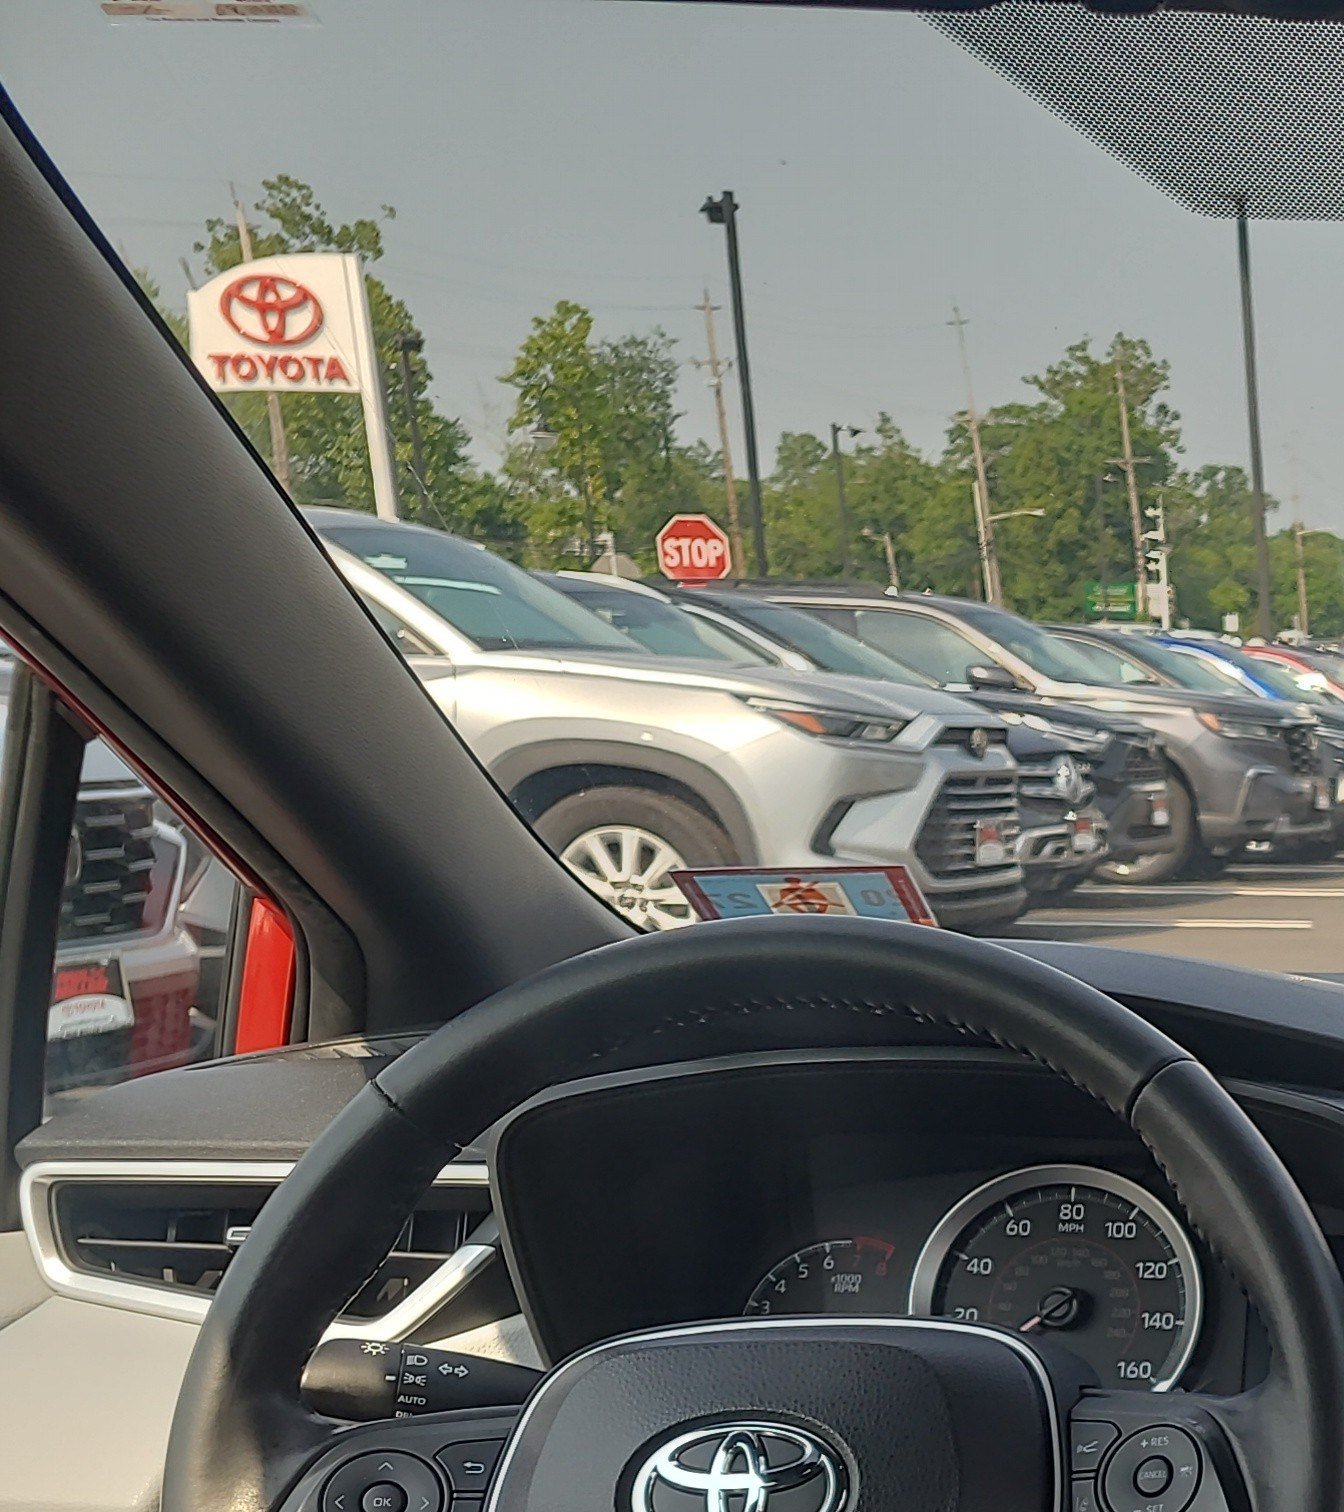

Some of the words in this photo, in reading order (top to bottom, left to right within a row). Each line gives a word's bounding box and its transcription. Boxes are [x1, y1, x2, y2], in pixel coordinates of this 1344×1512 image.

[207, 353, 350, 384] TOYOTA
[662, 536, 724, 568] STOP
[1059, 1203, 1085, 1220] 80
[1005, 1219, 1031, 1237] 60
[1058, 1222, 1084, 1233] MPH
[1104, 1221, 1137, 1239] 100
[823, 1255, 835, 1270] 6
[876, 1262, 888, 1276] 8
[966, 1257, 992, 1275] 40
[1135, 1261, 1168, 1279] 120
[799, 1263, 809, 1279] 5
[774, 1279, 787, 1294] 4
[834, 1283, 860, 1294] RPM
[762, 1301, 770, 1315] 3
[954, 1307, 979, 1321] 20
[1141, 1312, 1175, 1330] 140
[1117, 1361, 1152, 1379] 160
[397, 1394, 427, 1406] AUTO
[1150, 1436, 1170, 1447] RES
[373, 1497, 392, 1507] OK
